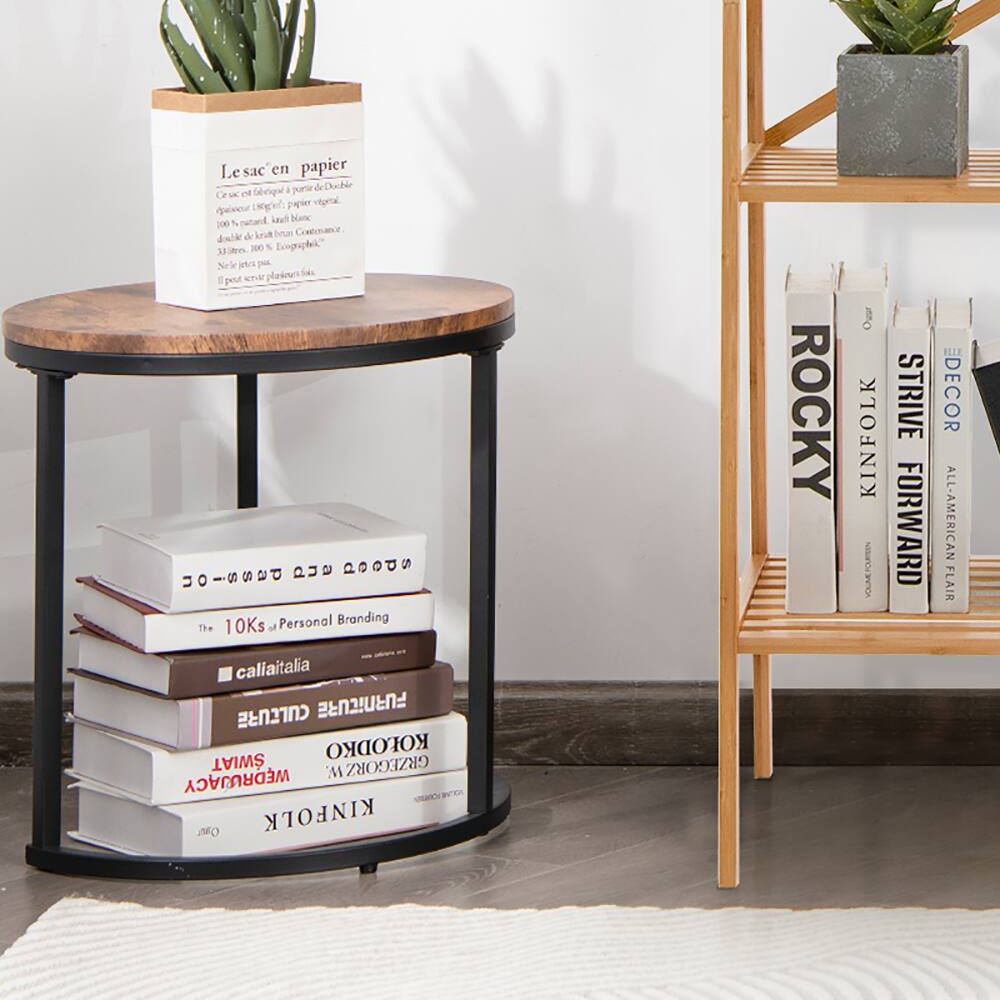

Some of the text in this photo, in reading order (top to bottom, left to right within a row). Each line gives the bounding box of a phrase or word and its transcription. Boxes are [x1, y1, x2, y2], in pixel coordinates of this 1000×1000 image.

[221, 163, 241, 179] Le
[271, 164, 289, 175] en
[301, 157, 347, 178] papier
[791, 325, 832, 500] ROCKY
[944, 357, 961, 432] DECOR
[859, 377, 877, 498] KINFOLK
[896, 353, 925, 586] STRIVE FORWARD
[944, 465, 957, 602] ALL-AMERICAN FLAIR
[181, 557, 413, 588] speed and passion
[198, 623, 214, 633] The
[224, 616, 266, 635] 10Ks
[278, 612, 333, 630] Personal
[337, 611, 390, 626] Branding
[236, 657, 311, 681] caliaitalia
[237, 691, 408, 729] FURNITURE CULTURE
[347, 754, 430, 777] GRZEGORZ
[264, 798, 375, 832] KINFOLK
